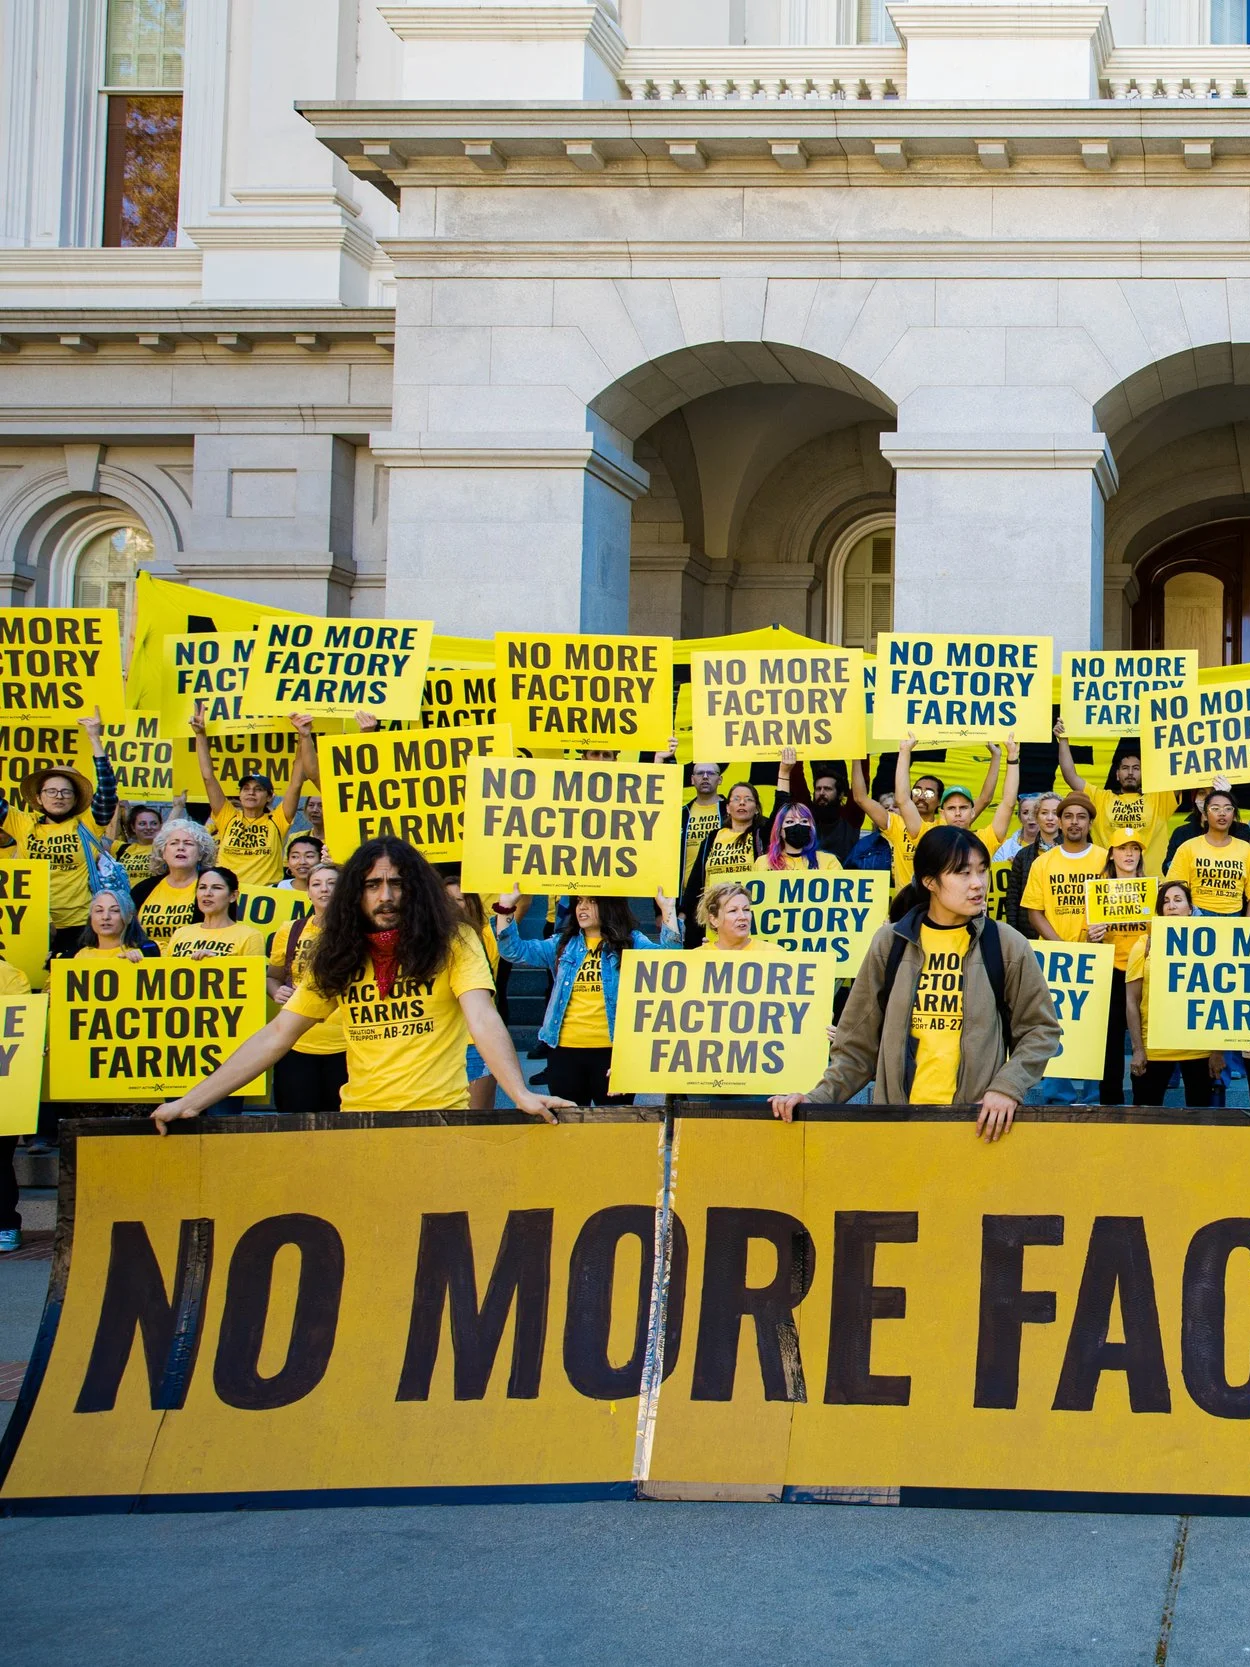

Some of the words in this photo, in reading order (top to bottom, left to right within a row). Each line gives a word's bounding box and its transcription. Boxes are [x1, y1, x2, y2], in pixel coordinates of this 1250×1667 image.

[268, 624, 313, 647] NO
[324, 625, 418, 650] MORE
[0, 650, 100, 676] TORY
[176, 641, 219, 665] NO
[265, 651, 410, 677] FACTORY
[508, 642, 551, 669] NO
[565, 644, 658, 672] MORE
[890, 641, 933, 665] NO
[947, 643, 1038, 668] MORE
[704, 659, 746, 685] NO
[760, 657, 850, 684] MORE
[1072, 657, 1105, 677] NO
[1115, 656, 1186, 677] MORE
[2, 682, 84, 709] RMS
[276, 678, 388, 704] FARMS
[512, 674, 654, 703] FACTORY
[891, 670, 1034, 697] FACTORY
[708, 688, 848, 716] FACTORY
[907, 700, 1017, 726] FARMS
[1086, 705, 1140, 725] FAR
[1150, 695, 1188, 722] NO
[529, 706, 638, 734] FARMS
[725, 719, 832, 746] FARMS
[332, 744, 379, 776] NO
[116, 767, 172, 788] ARM
[482, 768, 536, 799] NO
[553, 770, 665, 805] MORE
[338, 775, 466, 812] FACTOR
[484, 806, 660, 841] FACTORY
[688, 822, 719, 830] ACTOR
[503, 843, 638, 878] FARMS
[710, 855, 746, 866] FARMS
[1196, 858, 1210, 867] NO
[1215, 860, 1243, 870] MORE
[1050, 874, 1064, 884] NO
[1196, 869, 1243, 880] FACTORY
[1201, 879, 1236, 889] FARMS
[779, 878, 874, 903] MORE
[1052, 885, 1083, 895] FACTO
[1058, 896, 1085, 906] FARM
[1096, 884, 1110, 894] NO
[1115, 882, 1147, 892] MORE
[1097, 893, 1146, 905] FACTORY
[141, 914, 193, 925] FACTOR
[143, 905, 161, 914] NO
[166, 904, 195, 914] MOR
[1104, 905, 1141, 915] FARMS
[1166, 926, 1216, 957] NO
[67, 969, 119, 1002] NO
[137, 968, 248, 1000] MORE
[634, 961, 686, 994] NO
[703, 962, 816, 995] MORE
[70, 1006, 244, 1040] FACTORY
[350, 1000, 424, 1024] FARMS
[633, 1000, 810, 1035] FACTORY
[384, 1021, 434, 1039] AB-2764!
[90, 1045, 222, 1079] FARMS
[650, 1040, 784, 1074] FARMS
[74, 1212, 345, 1413] NO
[396, 1204, 919, 1406] MORE
